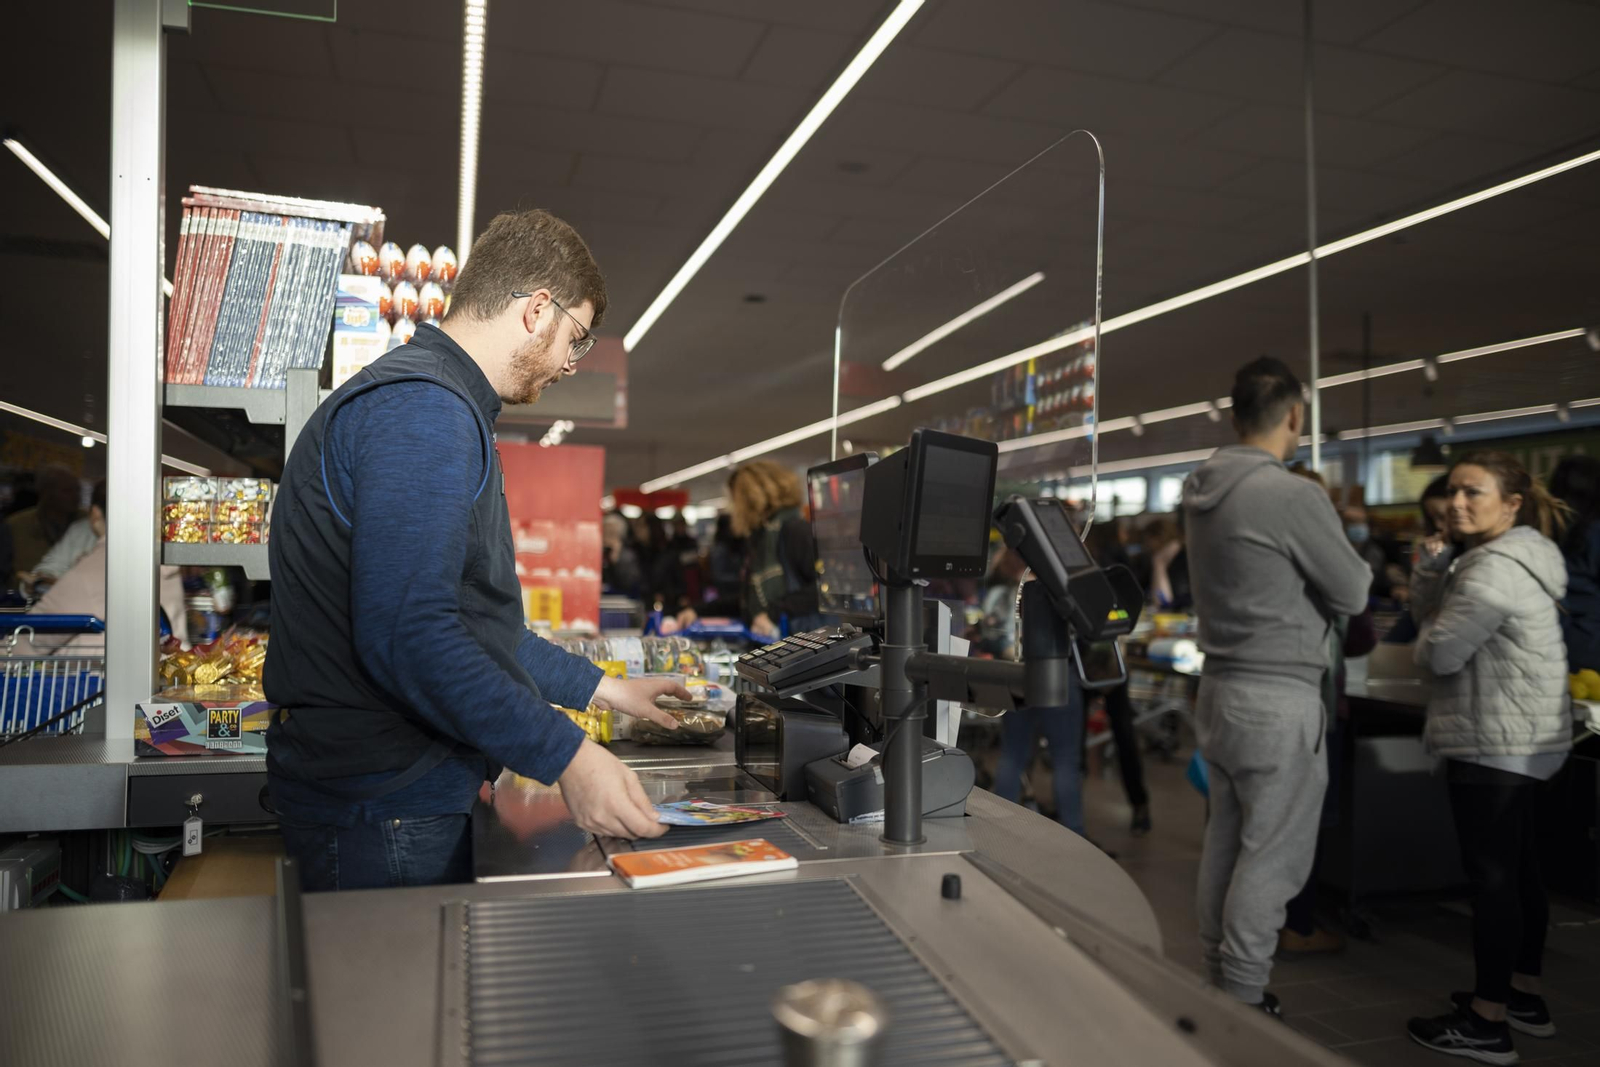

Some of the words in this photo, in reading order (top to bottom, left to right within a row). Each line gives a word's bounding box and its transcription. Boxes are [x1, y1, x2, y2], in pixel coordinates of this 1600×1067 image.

[152, 705, 180, 725] Diset
[210, 710, 239, 724] PARTY
[218, 723, 231, 737] &
